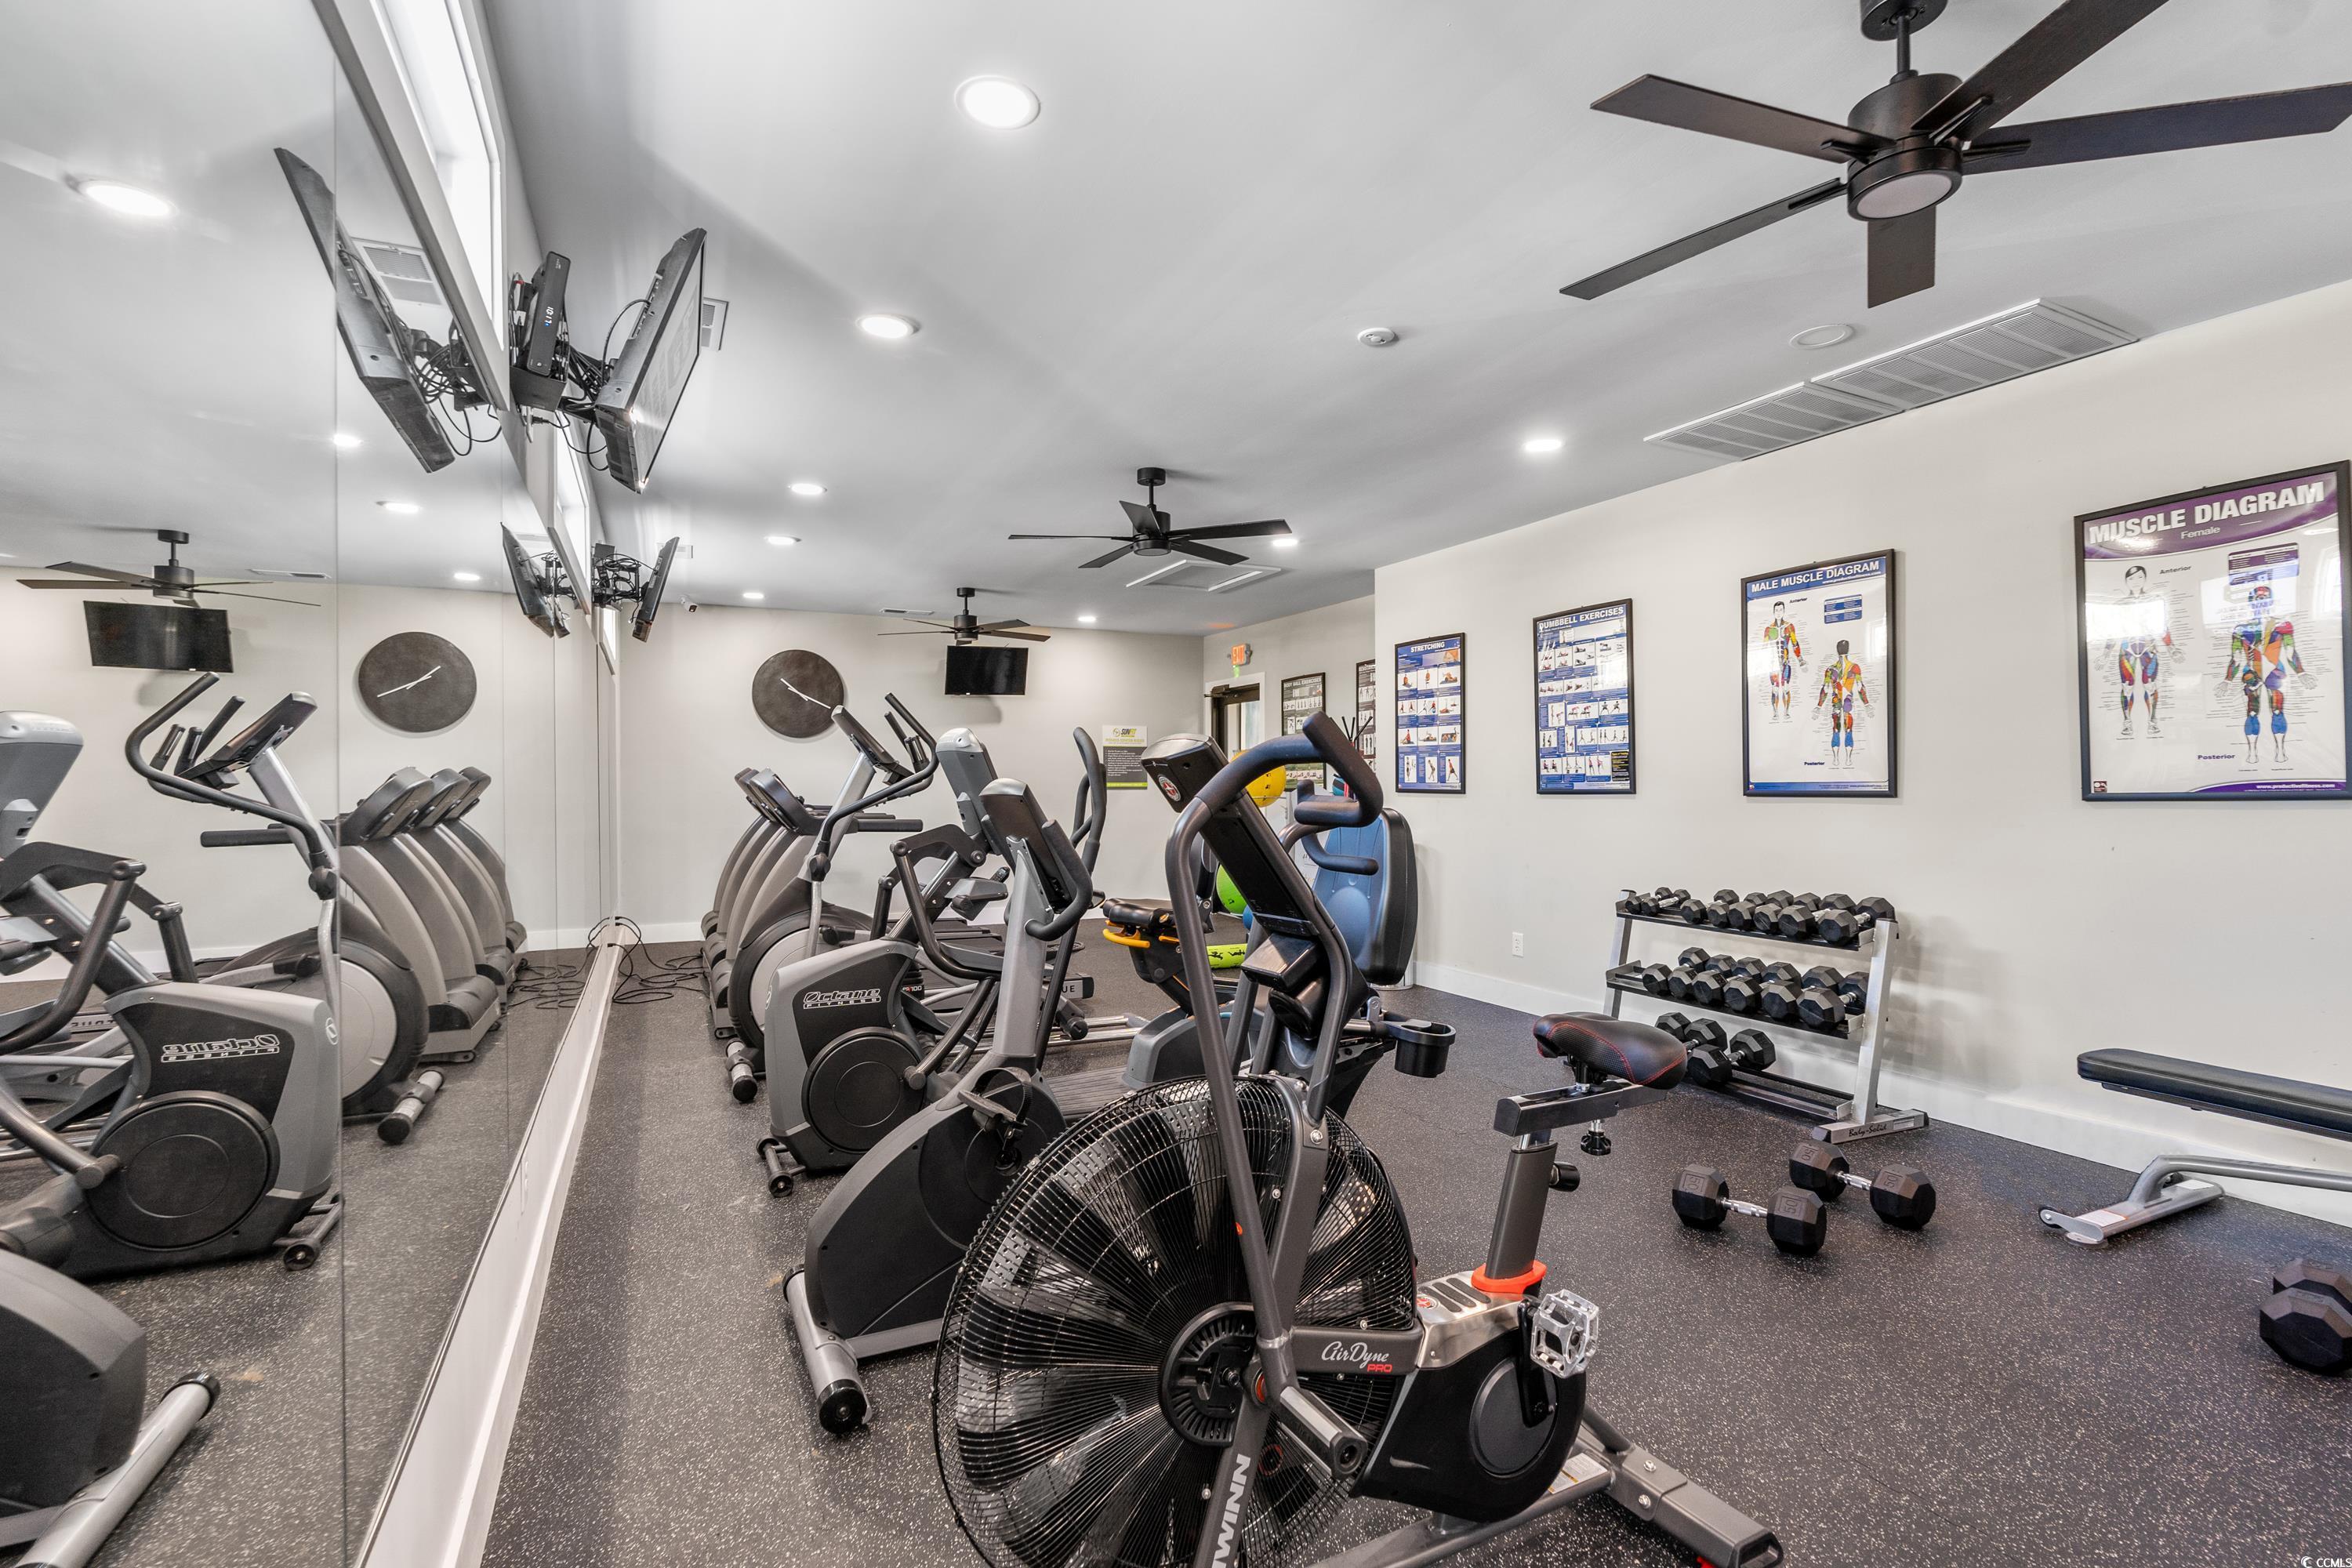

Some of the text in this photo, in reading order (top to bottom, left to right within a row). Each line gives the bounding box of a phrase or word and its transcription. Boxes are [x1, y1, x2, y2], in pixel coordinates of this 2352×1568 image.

[2089, 481, 2325, 545] MUSCLE DIAGRAM
[2180, 525, 2221, 539] Female
[2159, 564, 2192, 575] Anterior
[1751, 561, 1879, 593] MALE MUSCLE DIAGRAM
[1538, 615, 1578, 630] DUMBBELL
[1580, 607, 1624, 622] EXERCISES
[1410, 641, 1445, 653] STRETCHING
[803, 988, 881, 1003] Octane
[806, 998, 877, 1007] FITNESS
[1849, 1123, 1887, 1138] Body-Solid
[1687, 1175, 1702, 1190] 50
[1884, 1176, 1897, 1189] 50
[1785, 1200, 1798, 1214] 50
[1321, 1341, 1390, 1369] AirDyne
[1367, 1363, 1393, 1373] PRO
